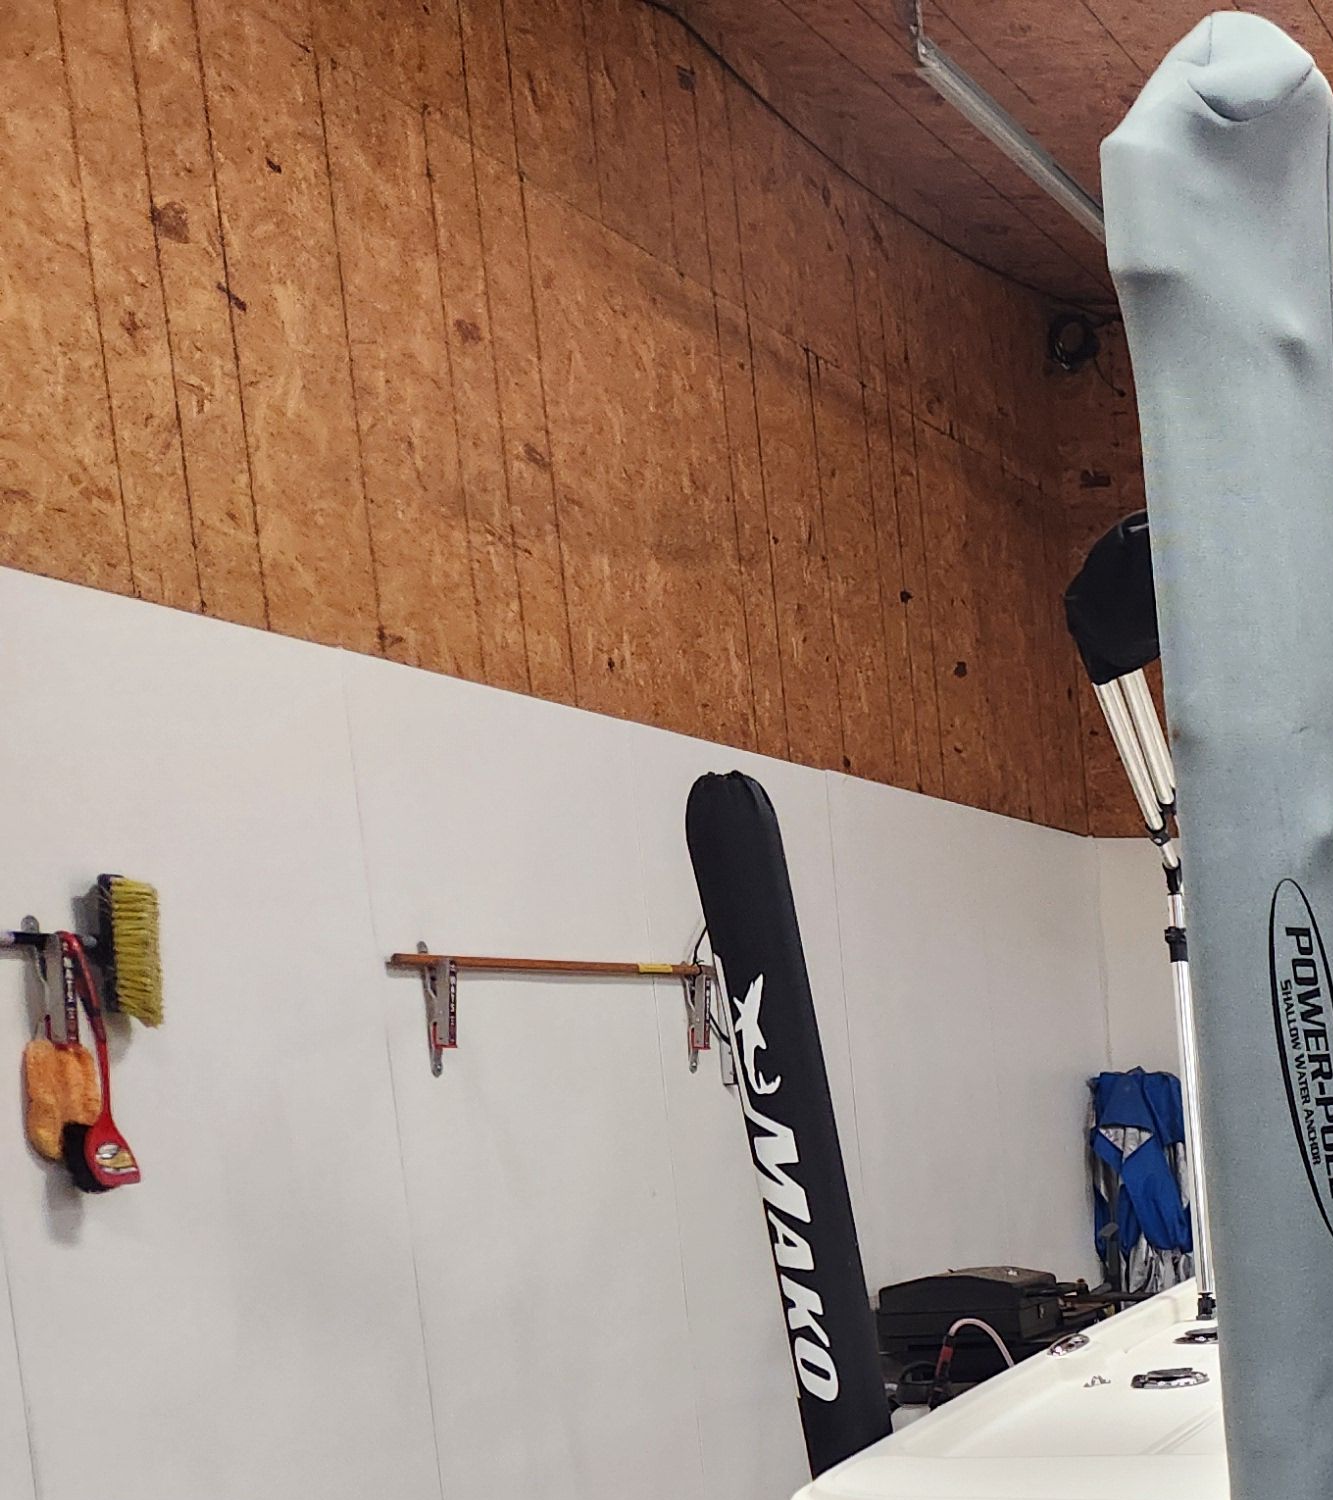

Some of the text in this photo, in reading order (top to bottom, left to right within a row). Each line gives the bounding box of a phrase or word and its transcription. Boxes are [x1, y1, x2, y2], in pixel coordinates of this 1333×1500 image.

[1279, 978, 1322, 1167] SHALLOW WATER ANCHOR
[728, 1060, 840, 1402] MAKO
